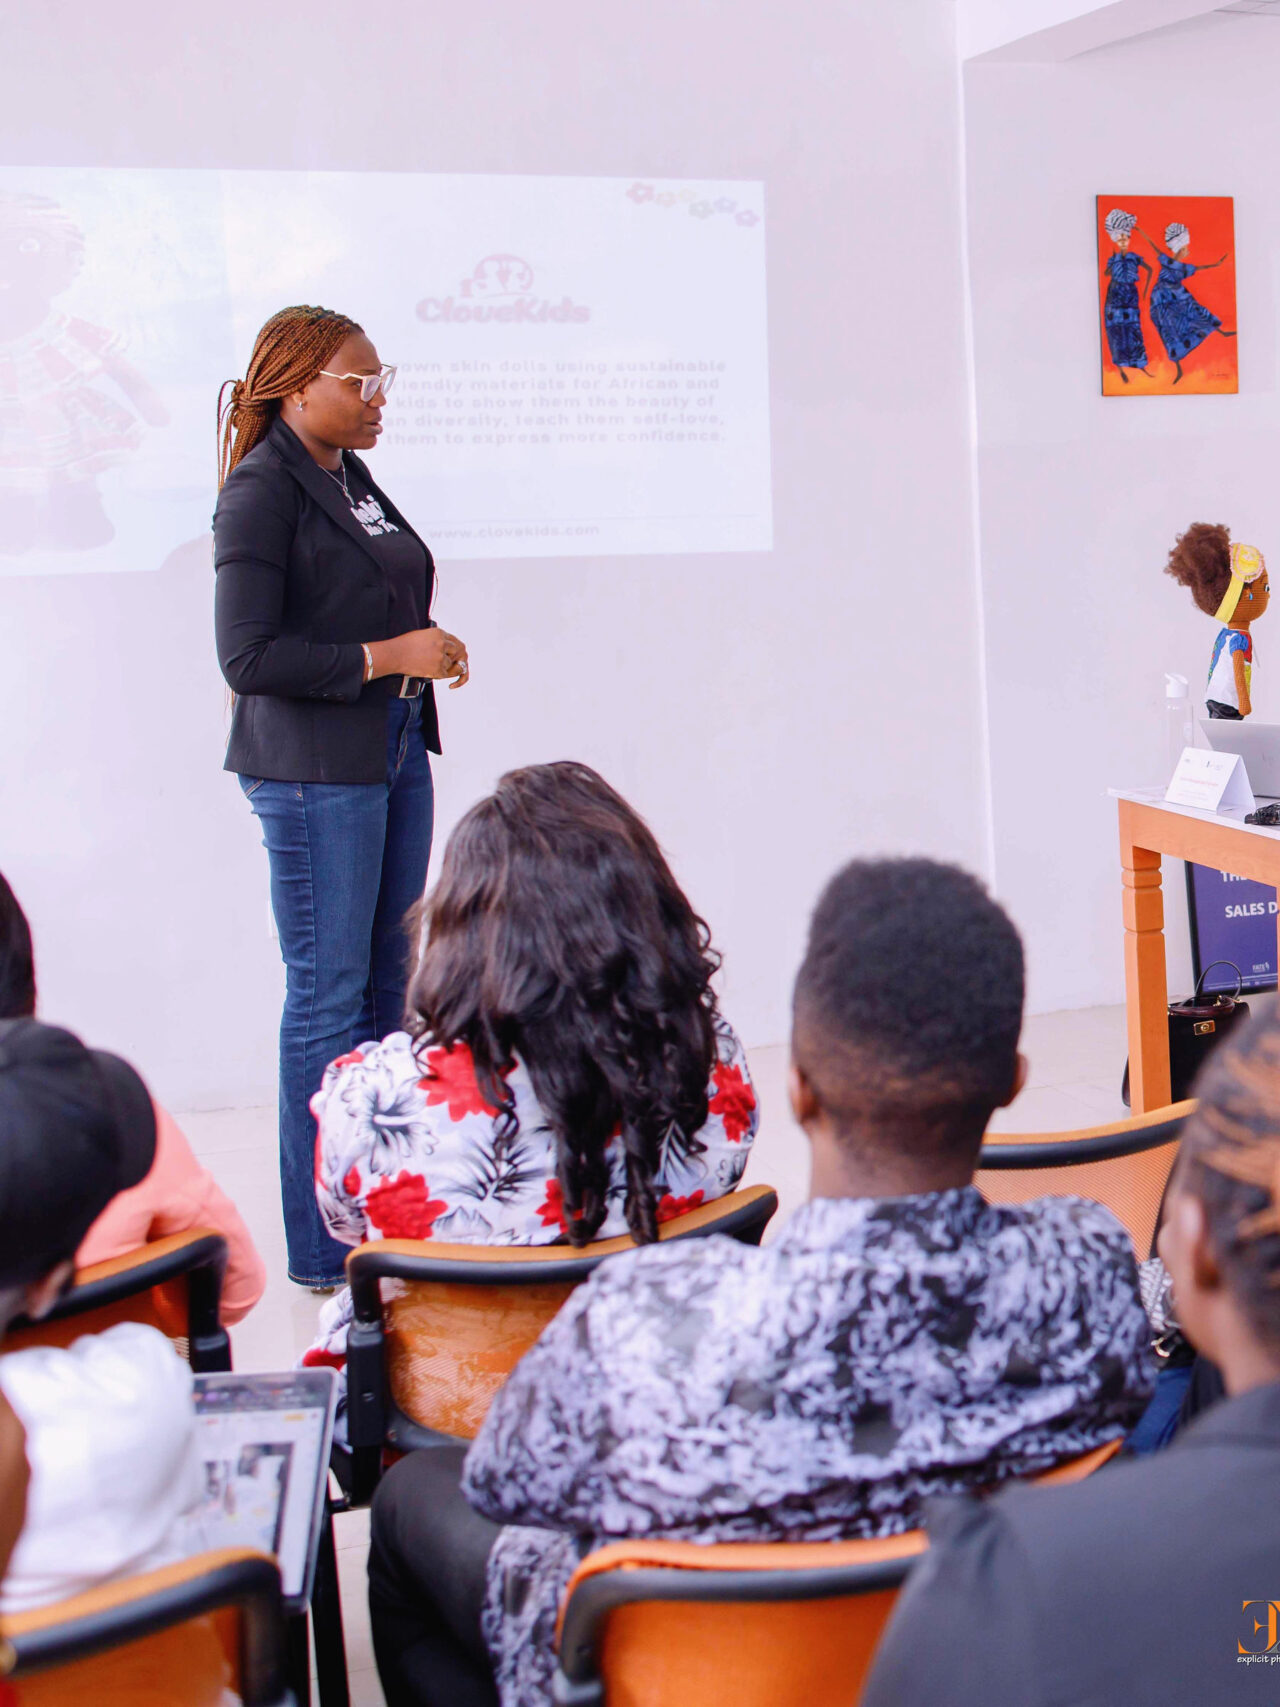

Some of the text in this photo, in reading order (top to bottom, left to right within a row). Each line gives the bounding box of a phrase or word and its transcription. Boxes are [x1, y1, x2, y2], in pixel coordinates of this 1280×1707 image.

[450, 360, 491, 373] skin
[499, 360, 548, 373] dolls
[555, 360, 608, 375] using
[615, 359, 727, 373] sustainable
[470, 378, 566, 391] materials
[573, 378, 601, 390] for
[608, 377, 679, 390] African
[686, 378, 720, 390] and
[396, 394, 715, 410] kids to show them the beauty of
[516, 413, 569, 426] teach
[577, 413, 625, 426] them
[386, 434, 438, 446] them
[445, 433, 464, 445] to
[472, 433, 551, 447] express
[558, 432, 609, 444] more
[1225, 902, 1265, 918] SALES
